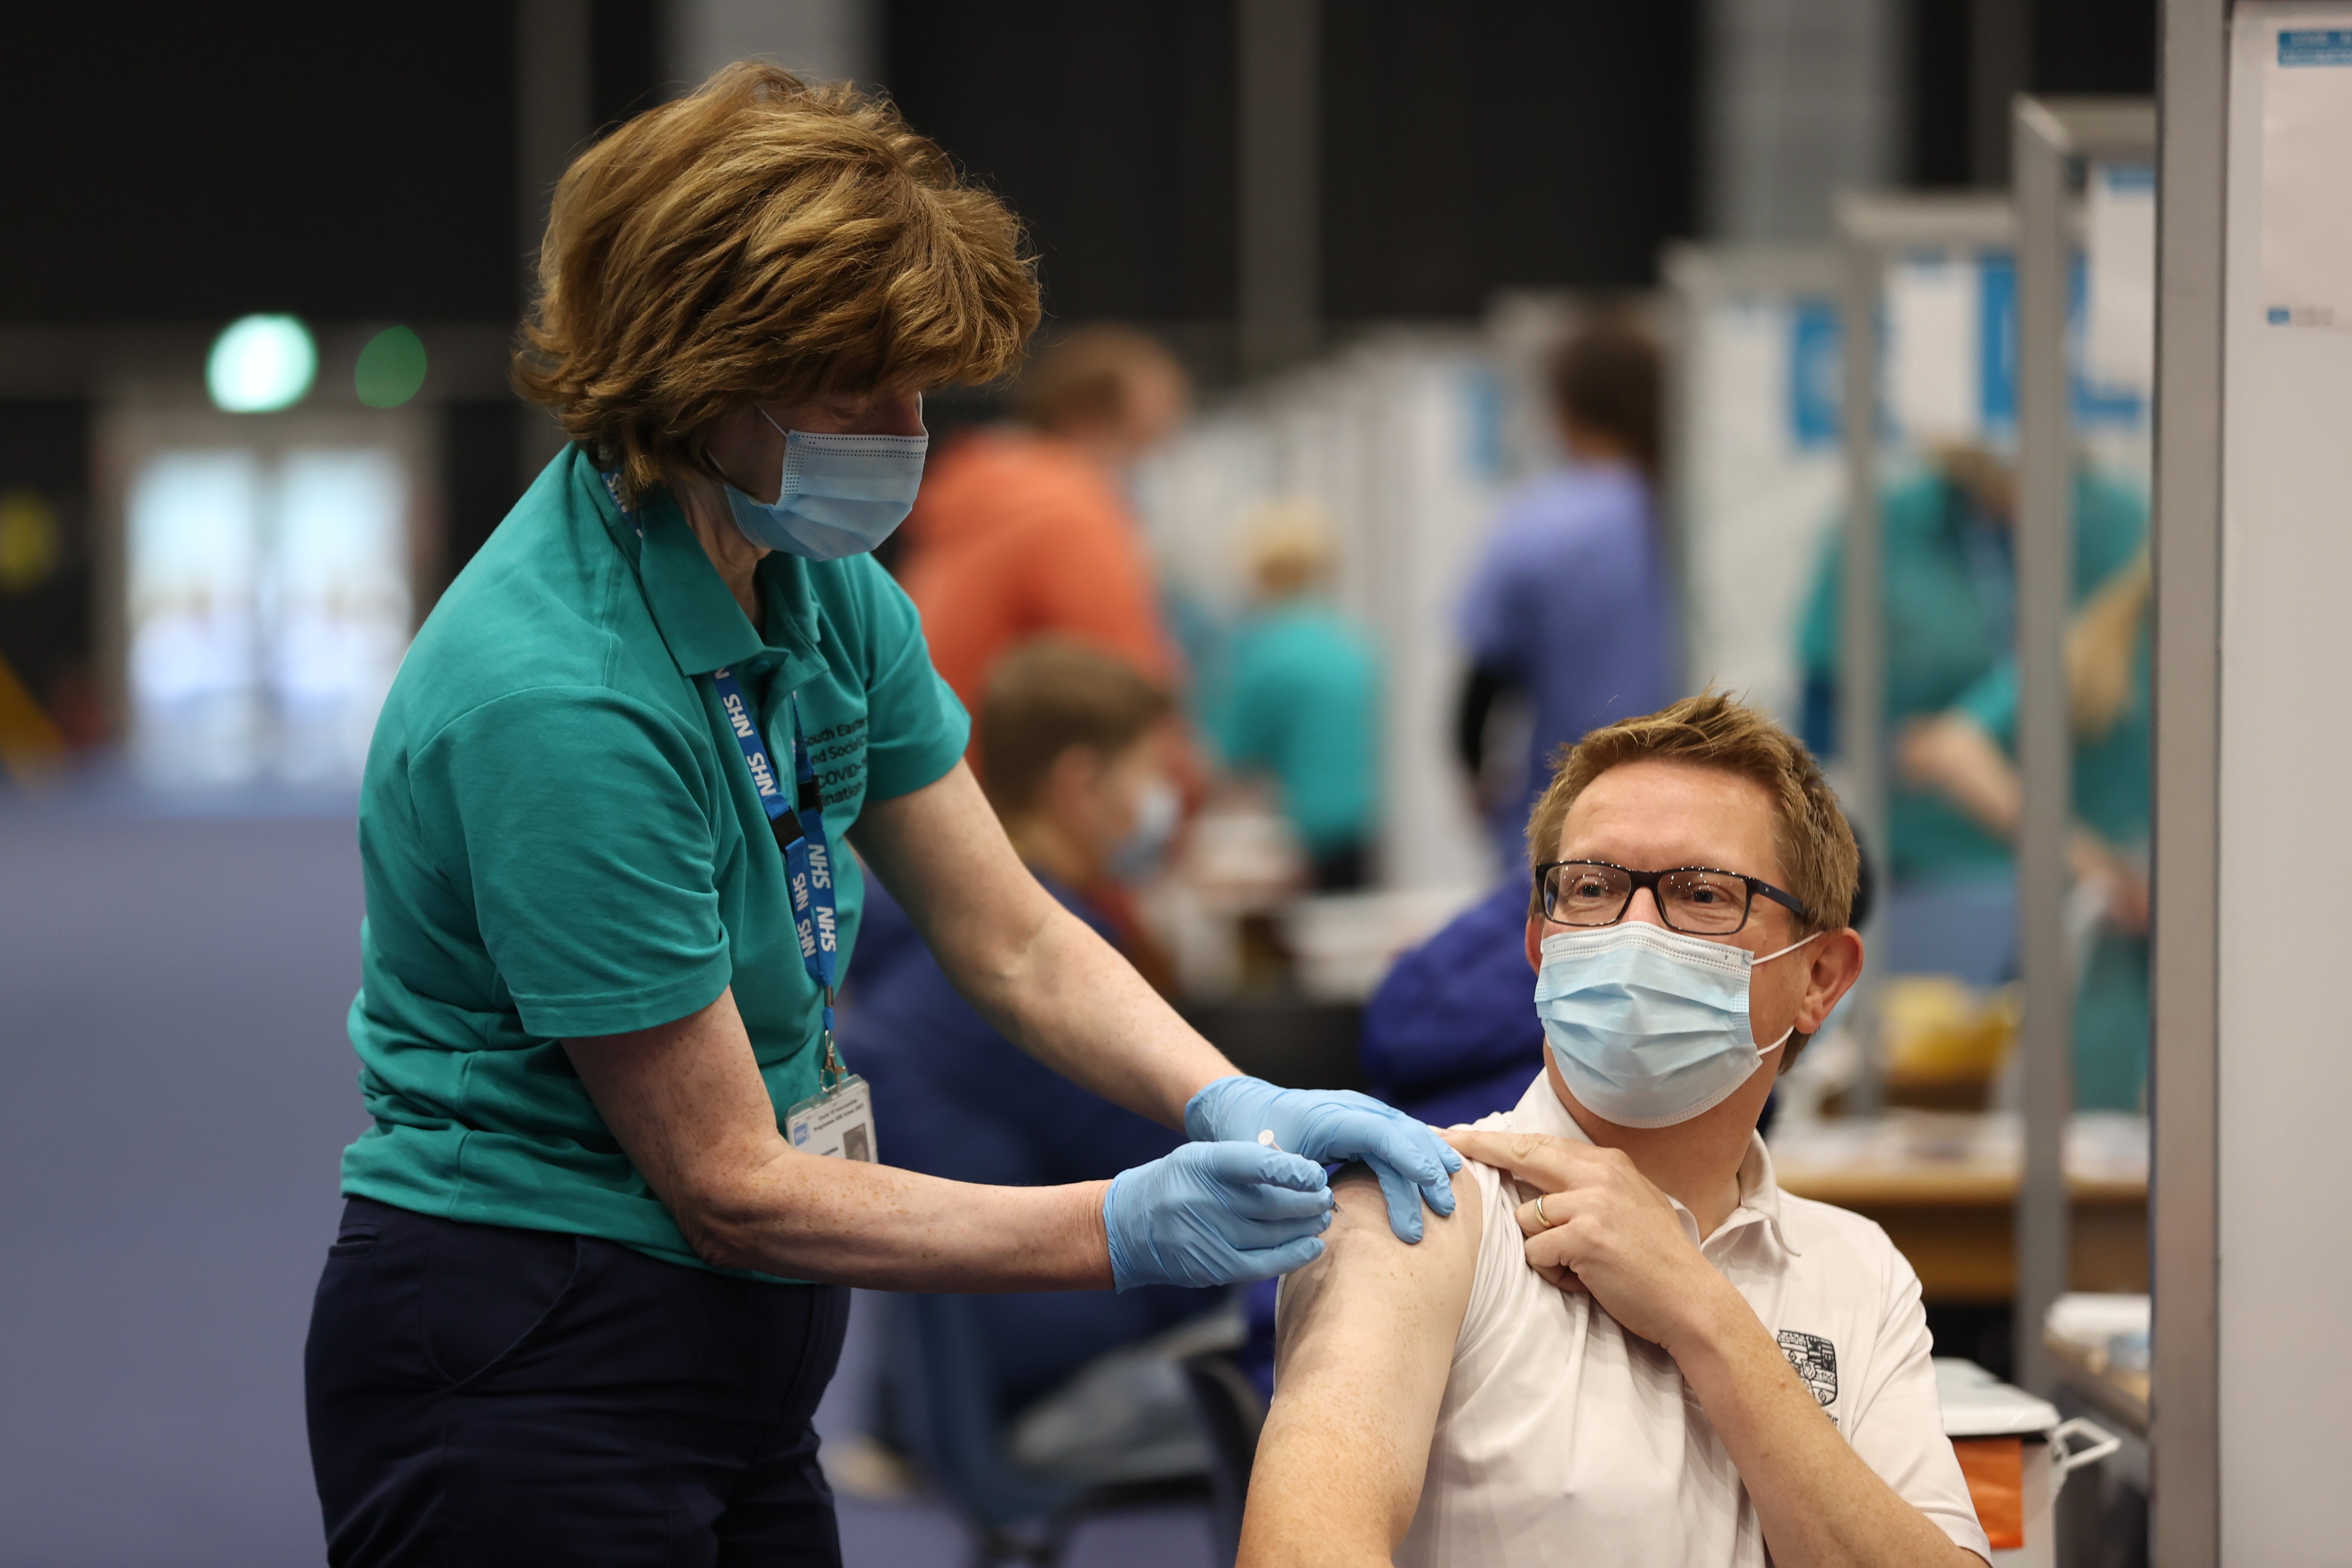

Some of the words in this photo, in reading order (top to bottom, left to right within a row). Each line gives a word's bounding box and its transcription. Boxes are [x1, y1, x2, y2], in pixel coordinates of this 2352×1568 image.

[723, 694, 754, 738] NHS
[746, 752, 777, 797] NHS
[811, 749, 827, 765] nd
[808, 844, 831, 889] NHS
[793, 873, 809, 911] NHS
[797, 919, 817, 958] NHS
[816, 906, 836, 952] NHS
